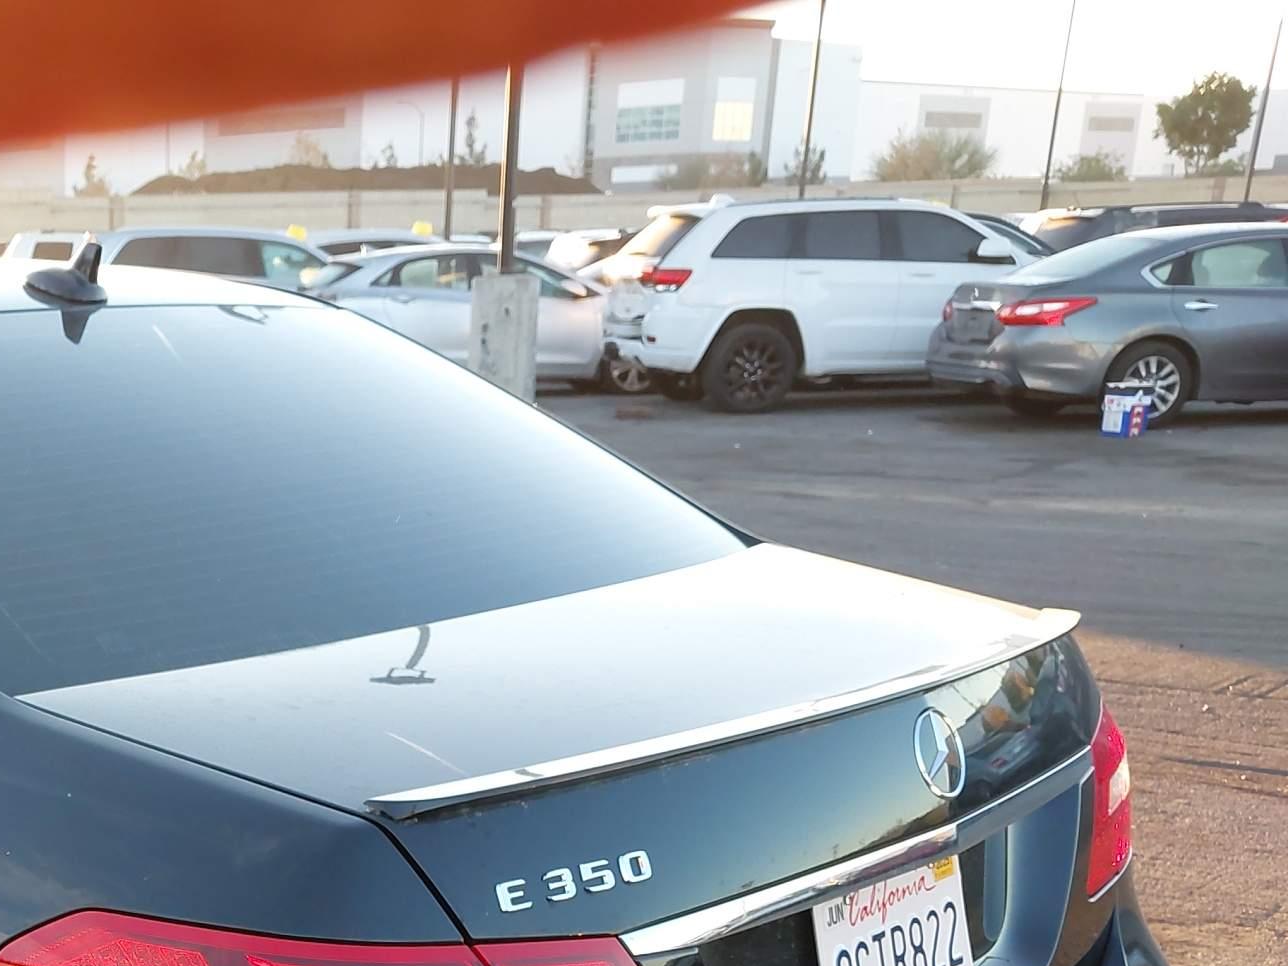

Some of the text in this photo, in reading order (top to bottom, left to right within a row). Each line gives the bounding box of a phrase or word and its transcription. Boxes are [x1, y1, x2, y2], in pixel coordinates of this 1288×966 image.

[496, 850, 653, 912] E 350
[848, 875, 937, 927] California
[827, 903, 845, 927] JUN
